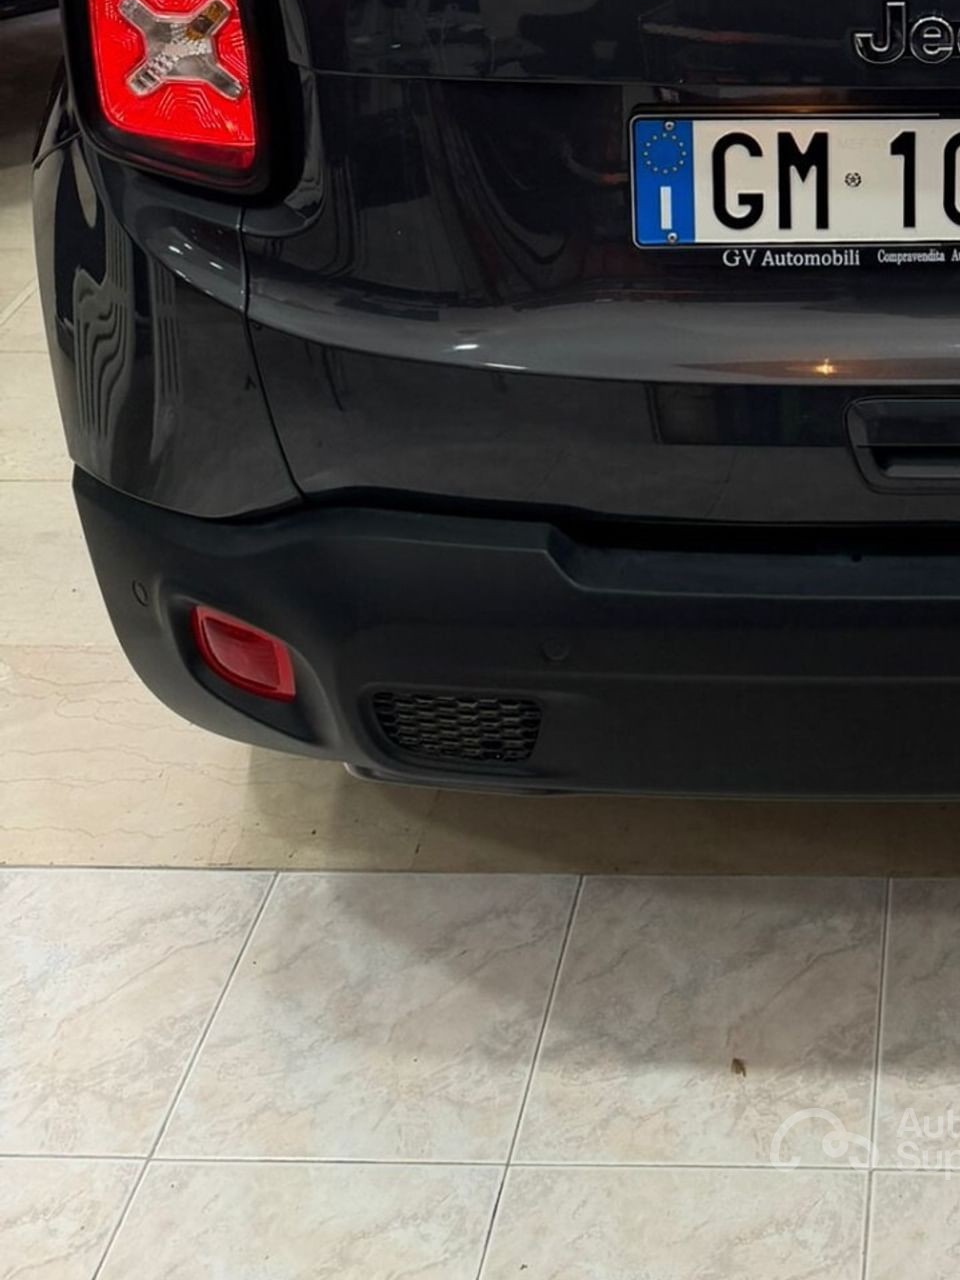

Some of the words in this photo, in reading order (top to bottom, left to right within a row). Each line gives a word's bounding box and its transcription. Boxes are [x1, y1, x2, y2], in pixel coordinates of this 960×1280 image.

[711, 131, 830, 230] GM
[722, 248, 757, 267] GV
[761, 248, 860, 267] Automobili
[877, 248, 945, 265] Compravendita
